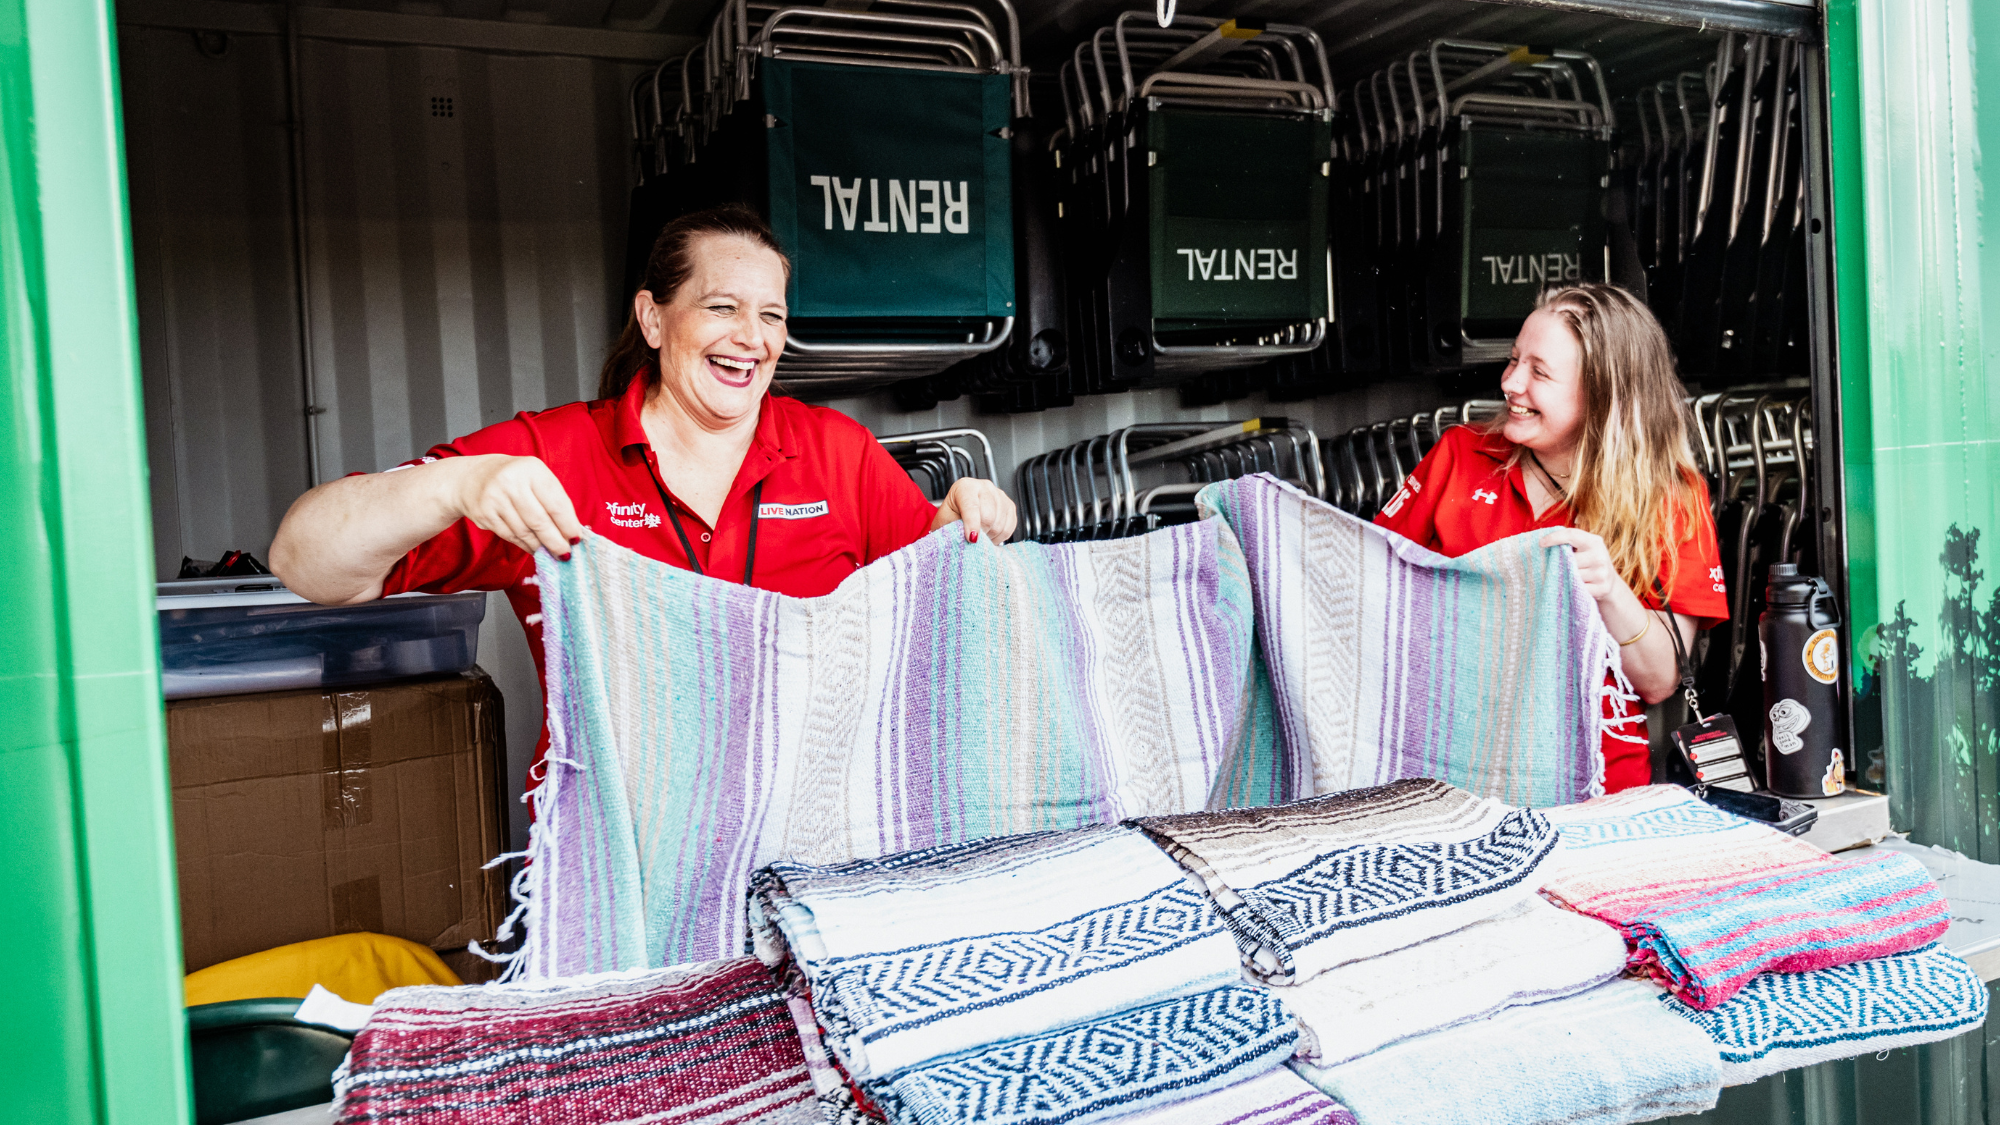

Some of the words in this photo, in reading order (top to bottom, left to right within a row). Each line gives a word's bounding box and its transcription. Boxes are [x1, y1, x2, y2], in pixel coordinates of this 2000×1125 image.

[810, 175, 969, 234] RENTAL
[1177, 249, 1297, 280] RENTAL
[1482, 253, 1580, 285] RENTAL
[605, 501, 646, 517] xfinity
[760, 507, 784, 516] LIVE
[785, 504, 823, 516] NATION
[610, 516, 645, 528] center
